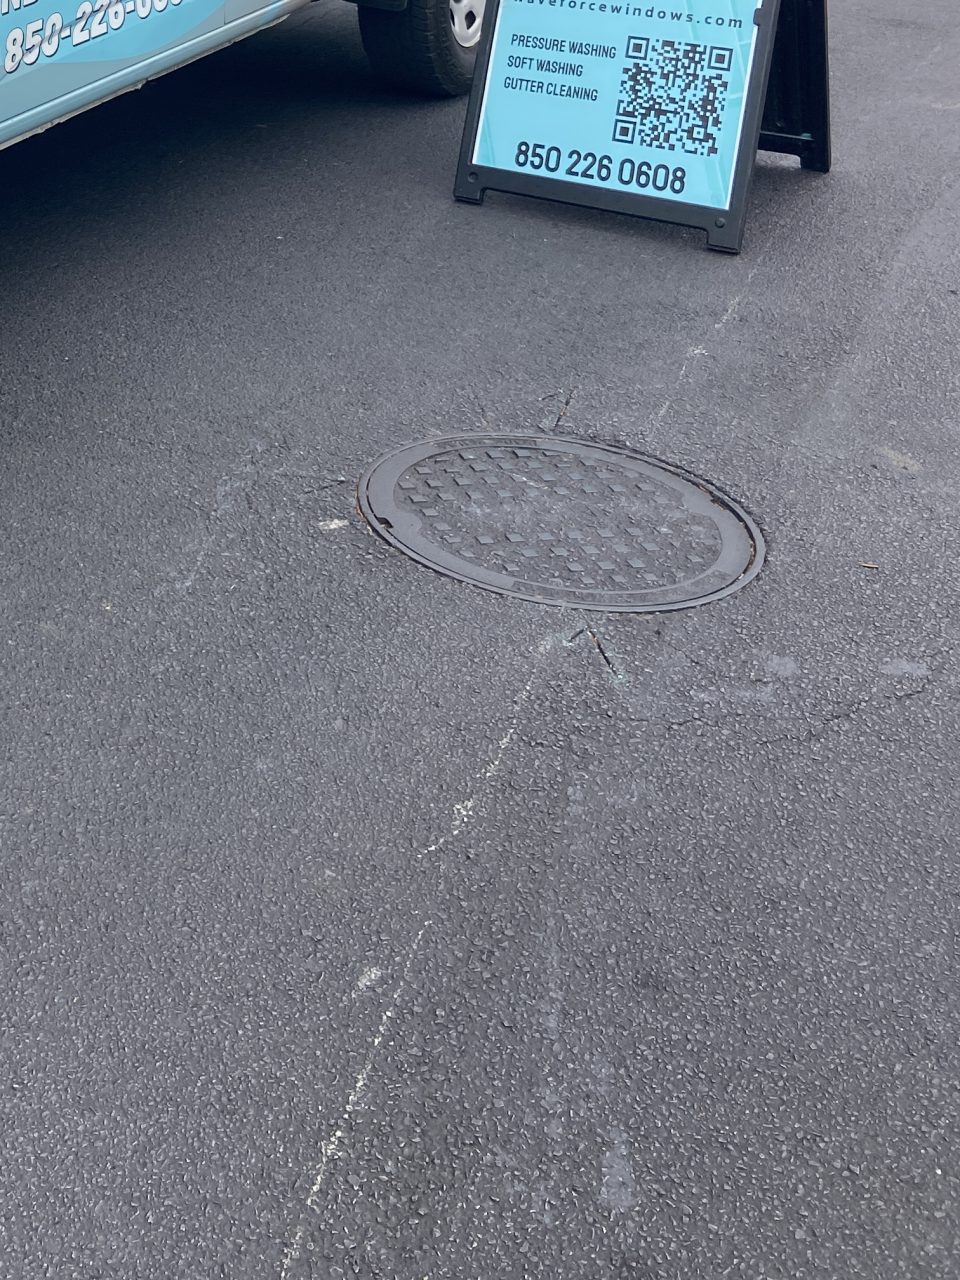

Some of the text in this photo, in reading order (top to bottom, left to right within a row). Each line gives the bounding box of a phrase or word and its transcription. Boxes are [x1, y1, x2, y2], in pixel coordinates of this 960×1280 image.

[511, 34, 617, 59] PRESSURE WASHING
[507, 55, 583, 77] SOFT WASHING
[504, 76, 598, 102] GUTTER CLEANING
[515, 141, 686, 194] 850 226 0608
